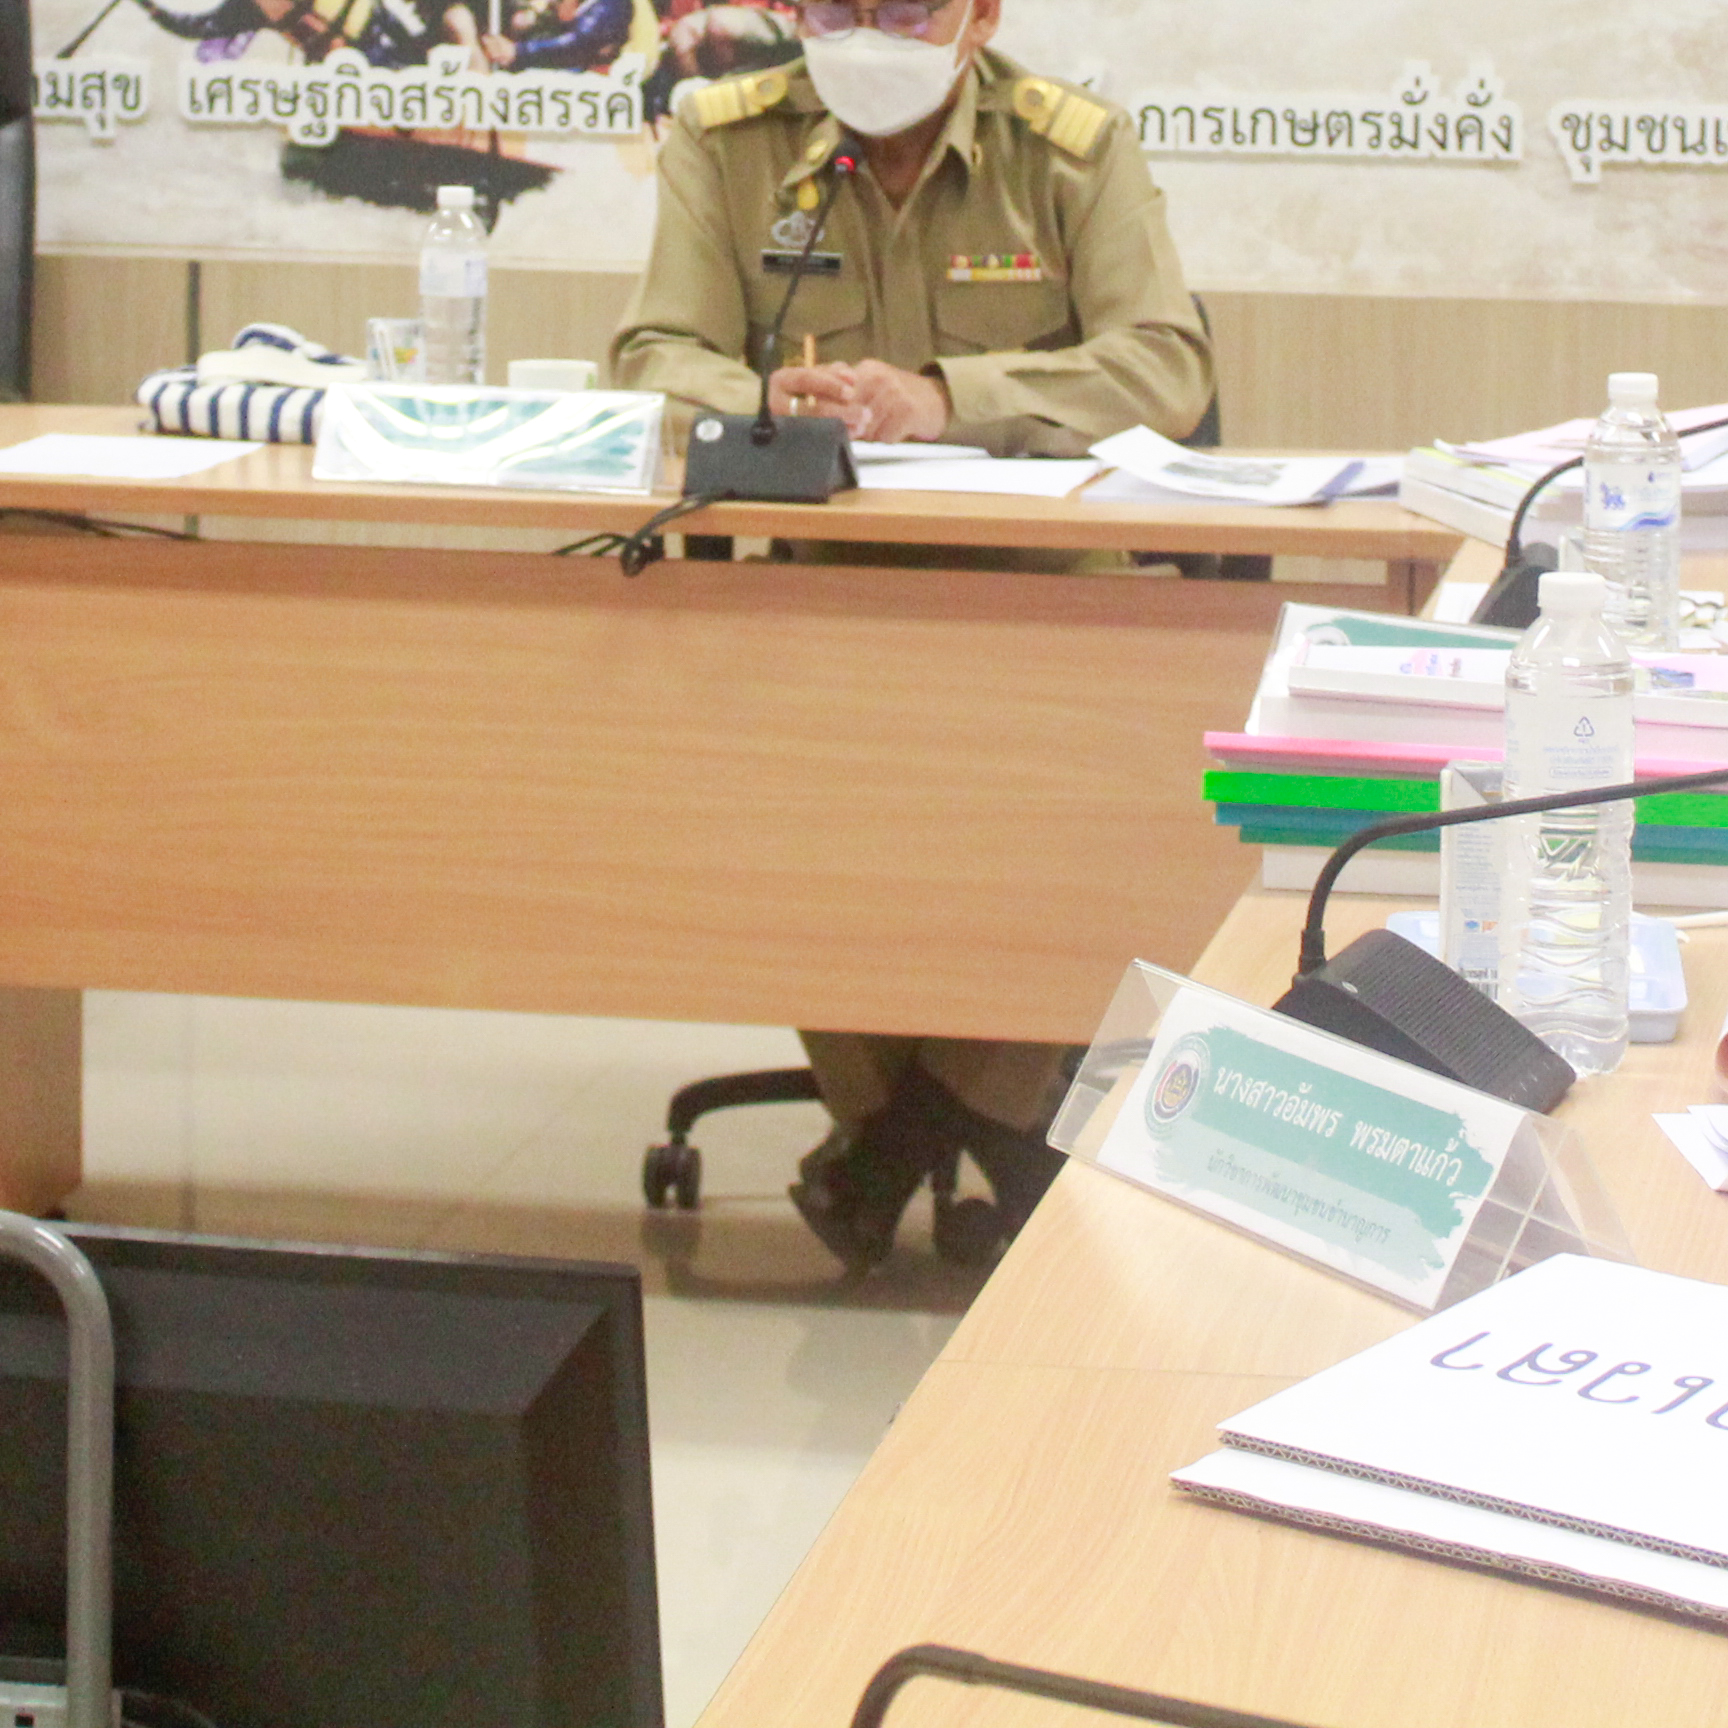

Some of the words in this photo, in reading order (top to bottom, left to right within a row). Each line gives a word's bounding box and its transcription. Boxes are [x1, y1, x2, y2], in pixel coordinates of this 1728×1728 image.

[188, 60, 640, 138] เศรษฐกิจสร้างสรรค์
[1138, 77, 1514, 153] การเกษตรมั่งคั่ง
[1213, 1066, 1343, 1138] นางสาวอัมพร
